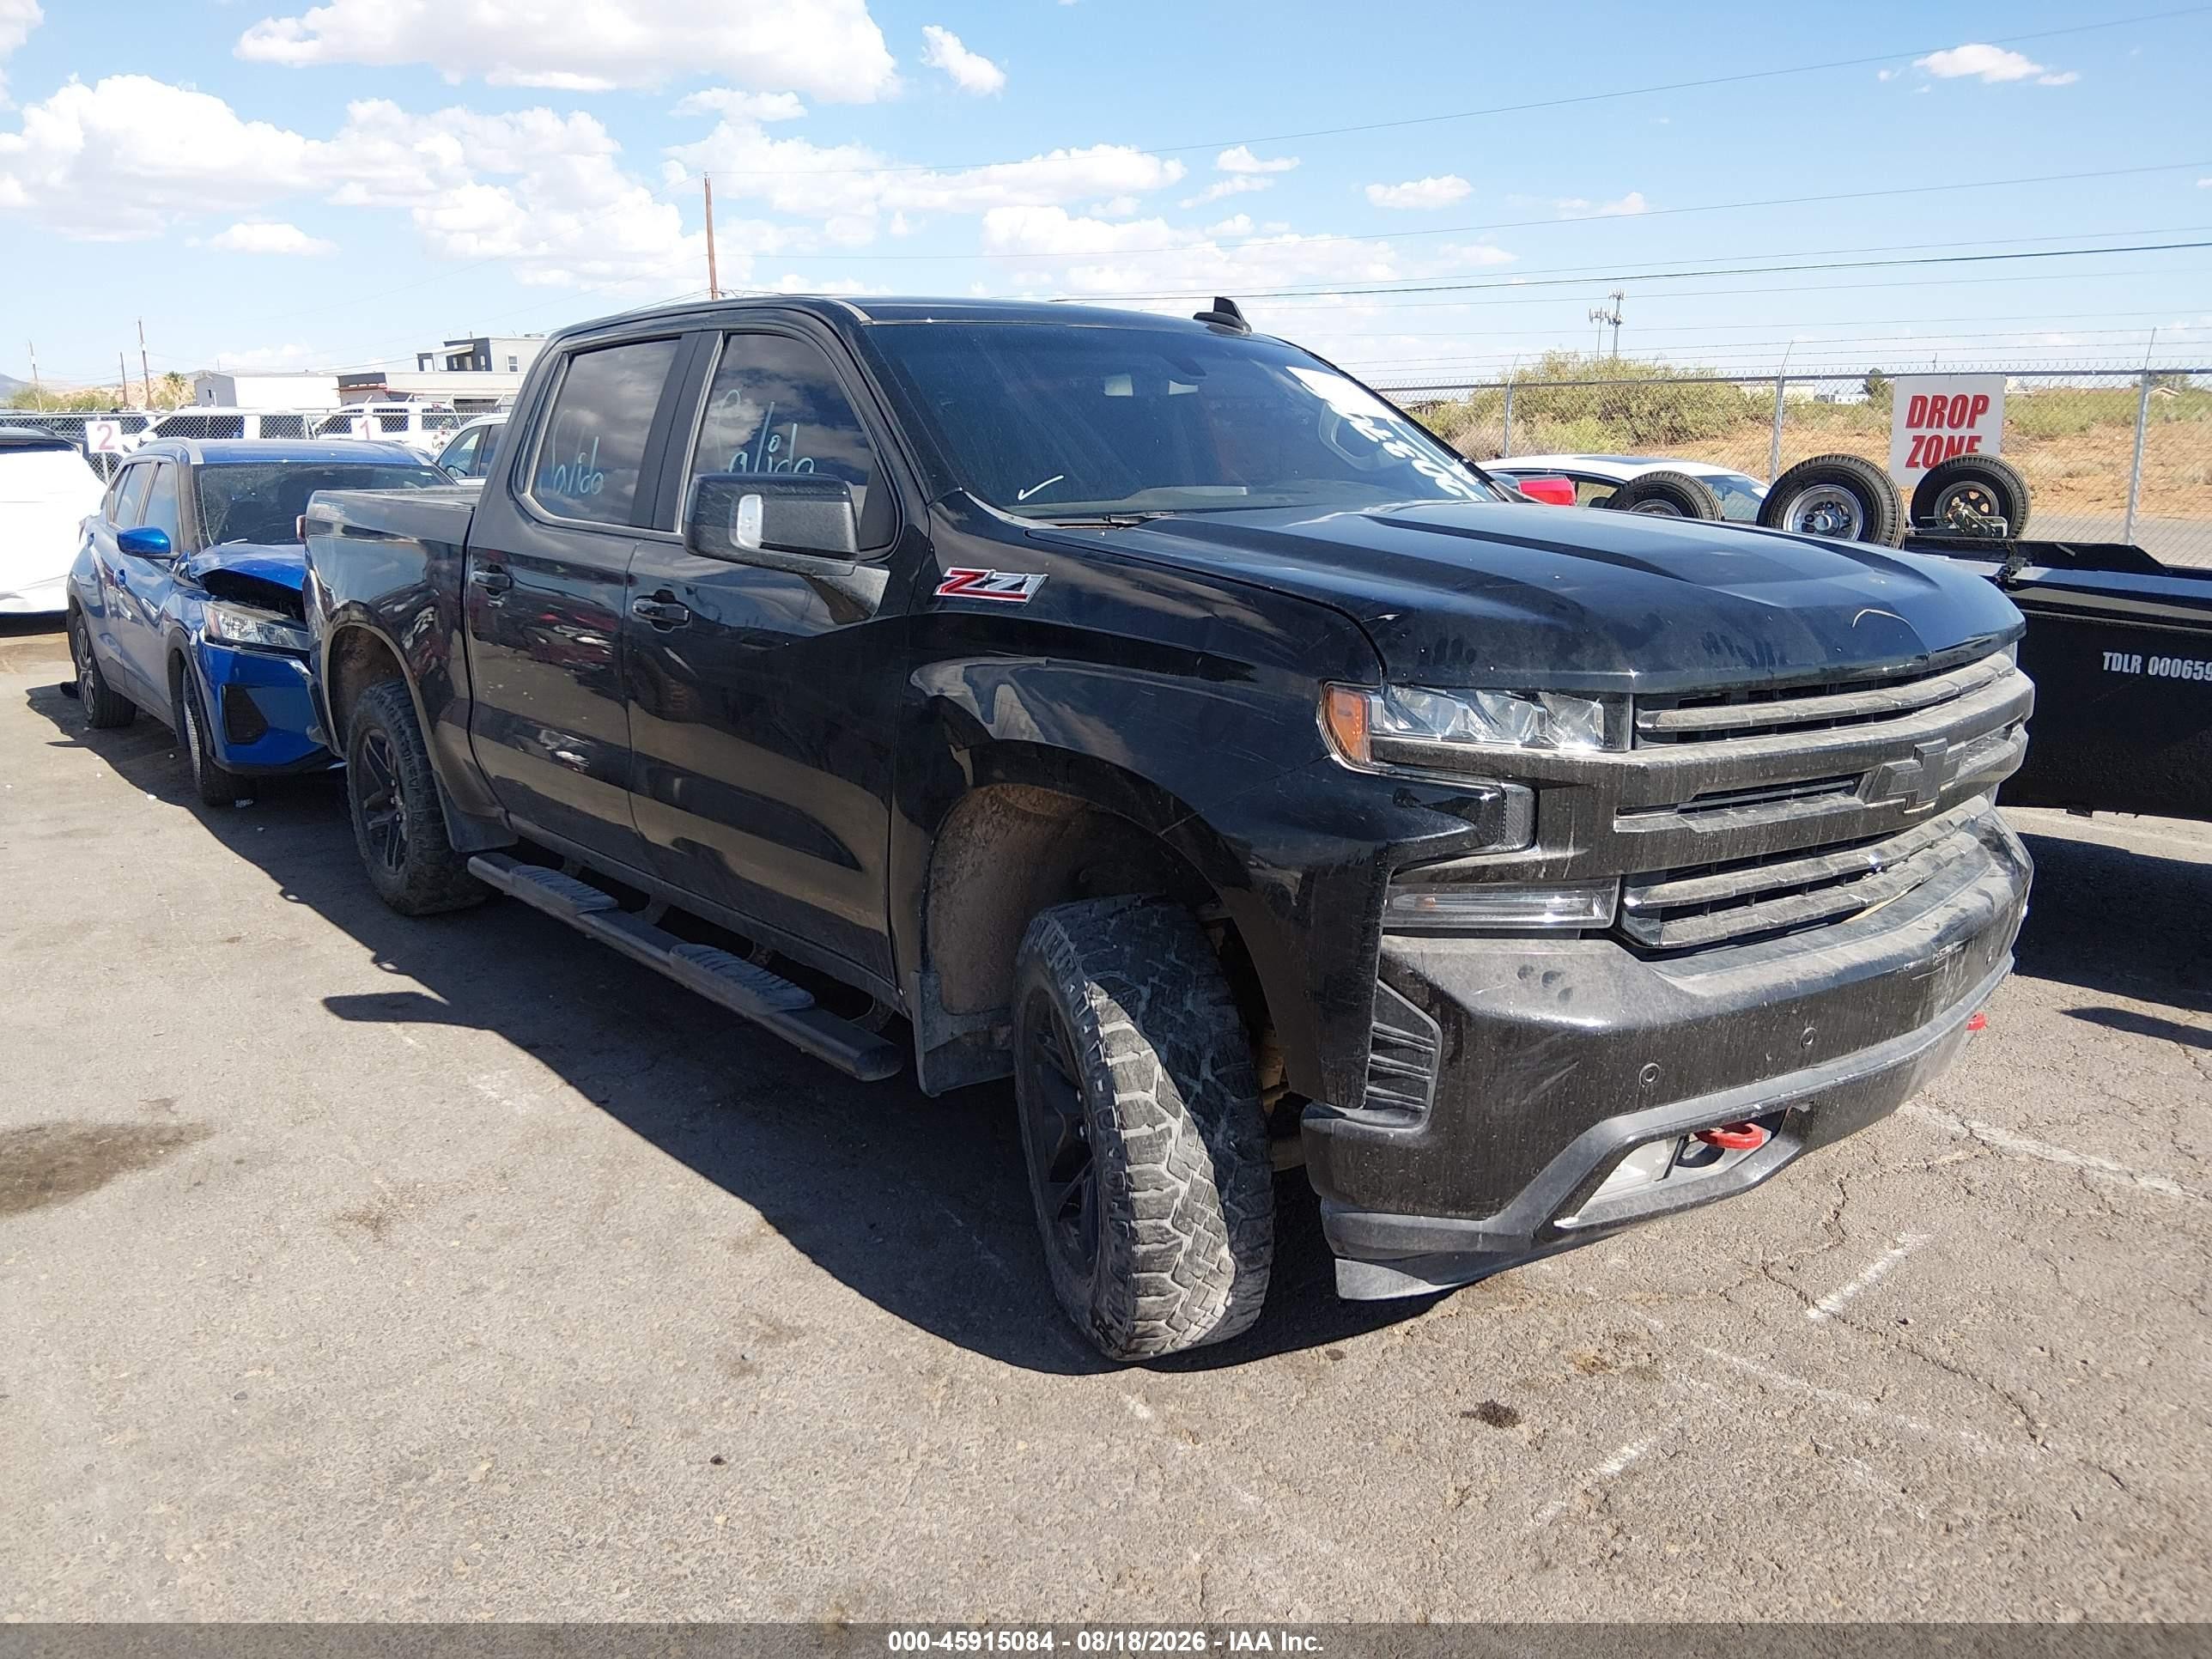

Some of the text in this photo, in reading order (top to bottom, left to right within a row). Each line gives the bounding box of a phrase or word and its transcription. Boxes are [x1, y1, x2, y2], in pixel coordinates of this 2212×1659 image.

[1905, 394, 1990, 430] DROP
[96, 423, 115, 450] 2
[360, 419, 370, 441] 1
[1905, 434, 1983, 470] ZONE
[933, 567, 1049, 604] Z71
[2102, 652, 2142, 674] TDLR
